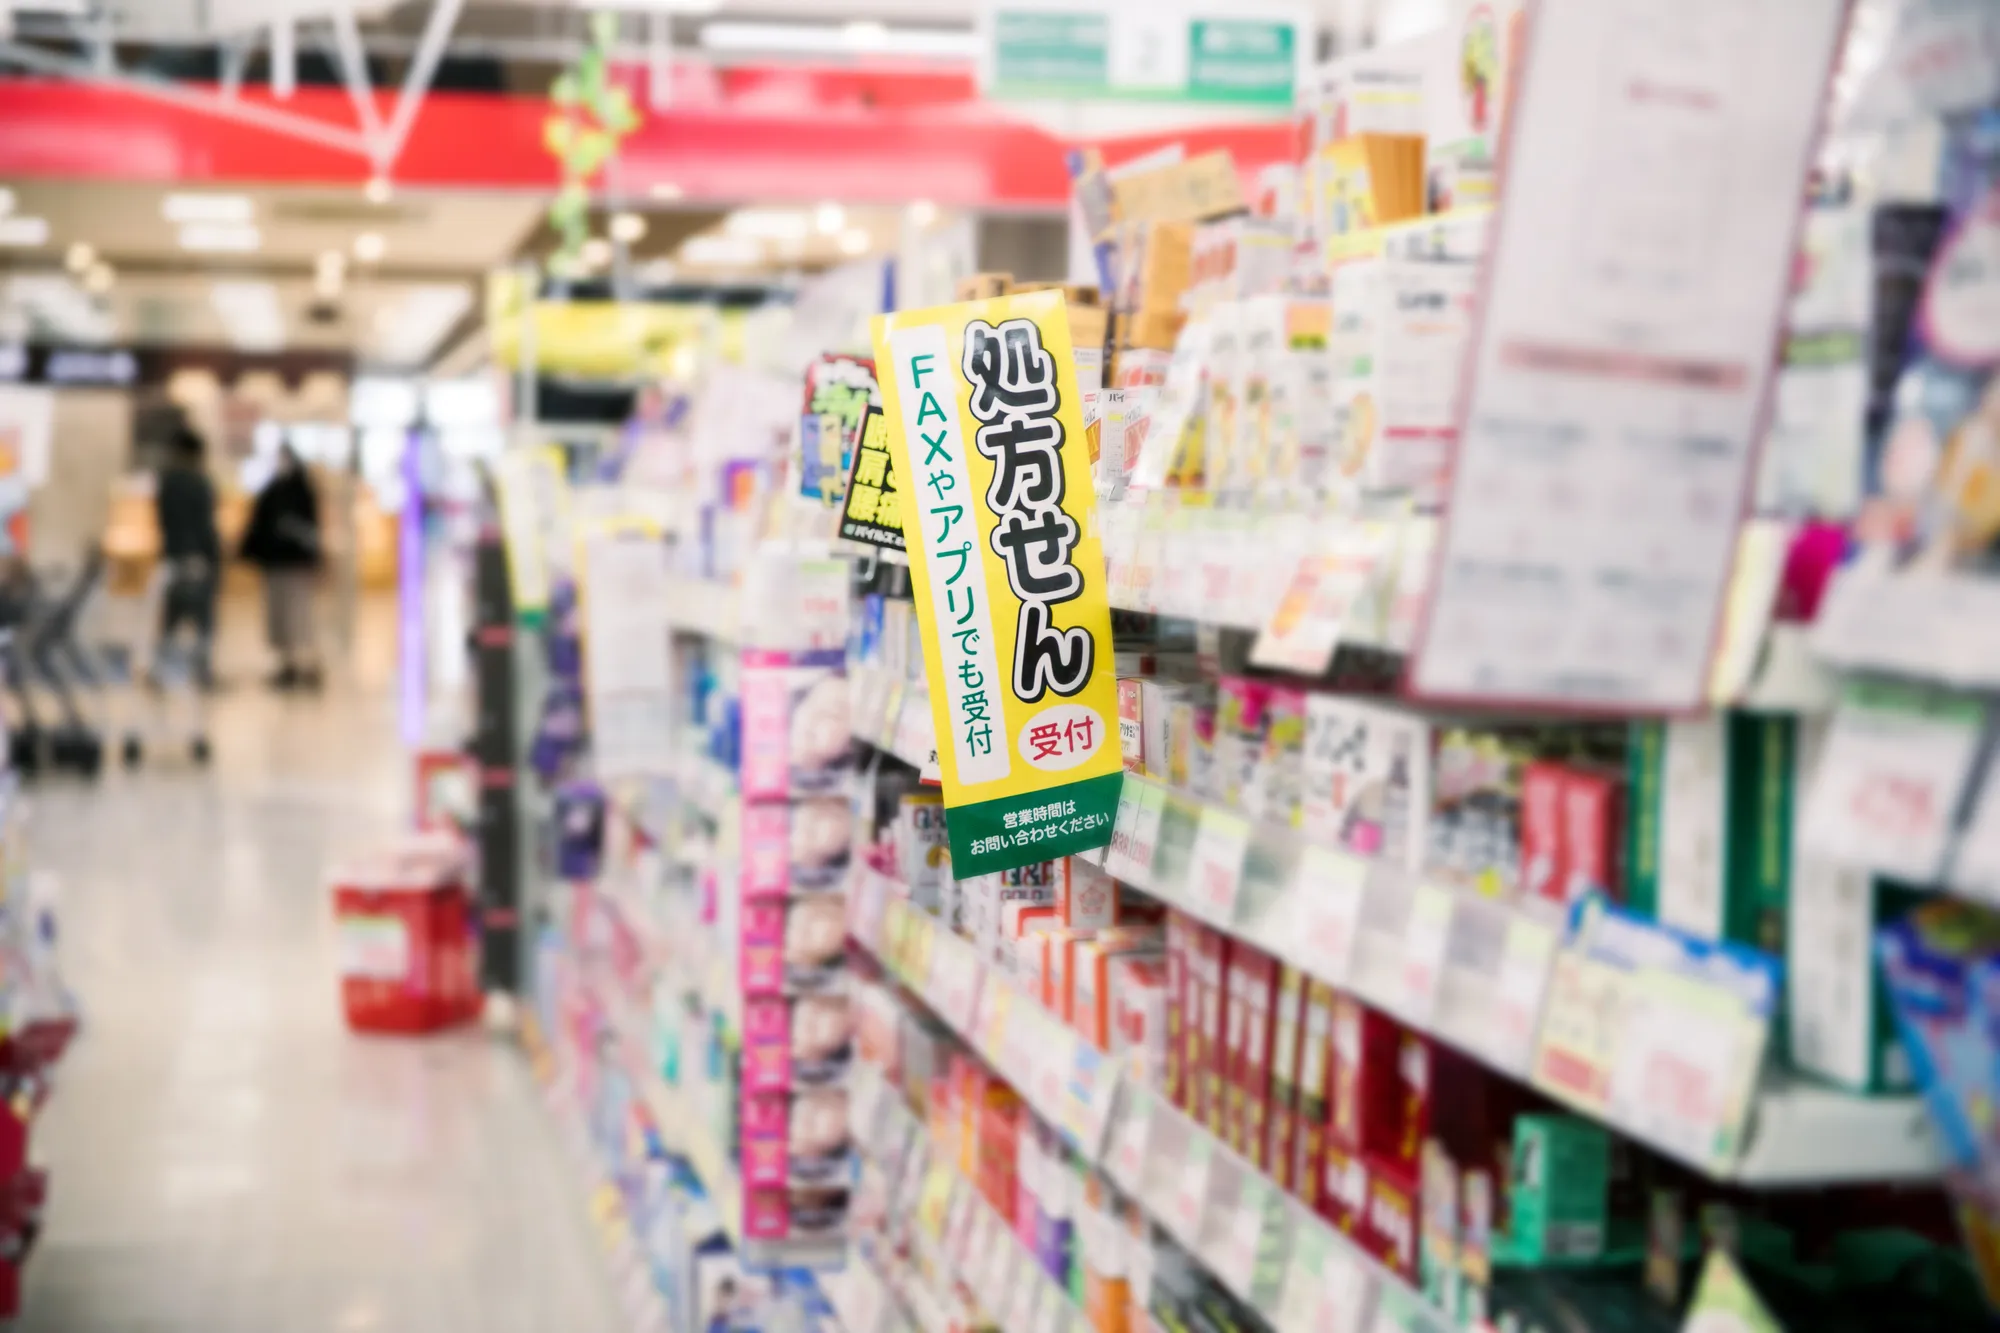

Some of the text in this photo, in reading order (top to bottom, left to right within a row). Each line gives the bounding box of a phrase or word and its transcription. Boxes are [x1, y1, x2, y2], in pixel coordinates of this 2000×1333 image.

[963, 318, 1094, 703] 処方せん
[910, 353, 993, 758] FAXやアプリでも受付
[1029, 715, 1094, 761] 受付
[970, 812, 1110, 856] お問い合わせください
[1002, 799, 1077, 829] 営業時間は
